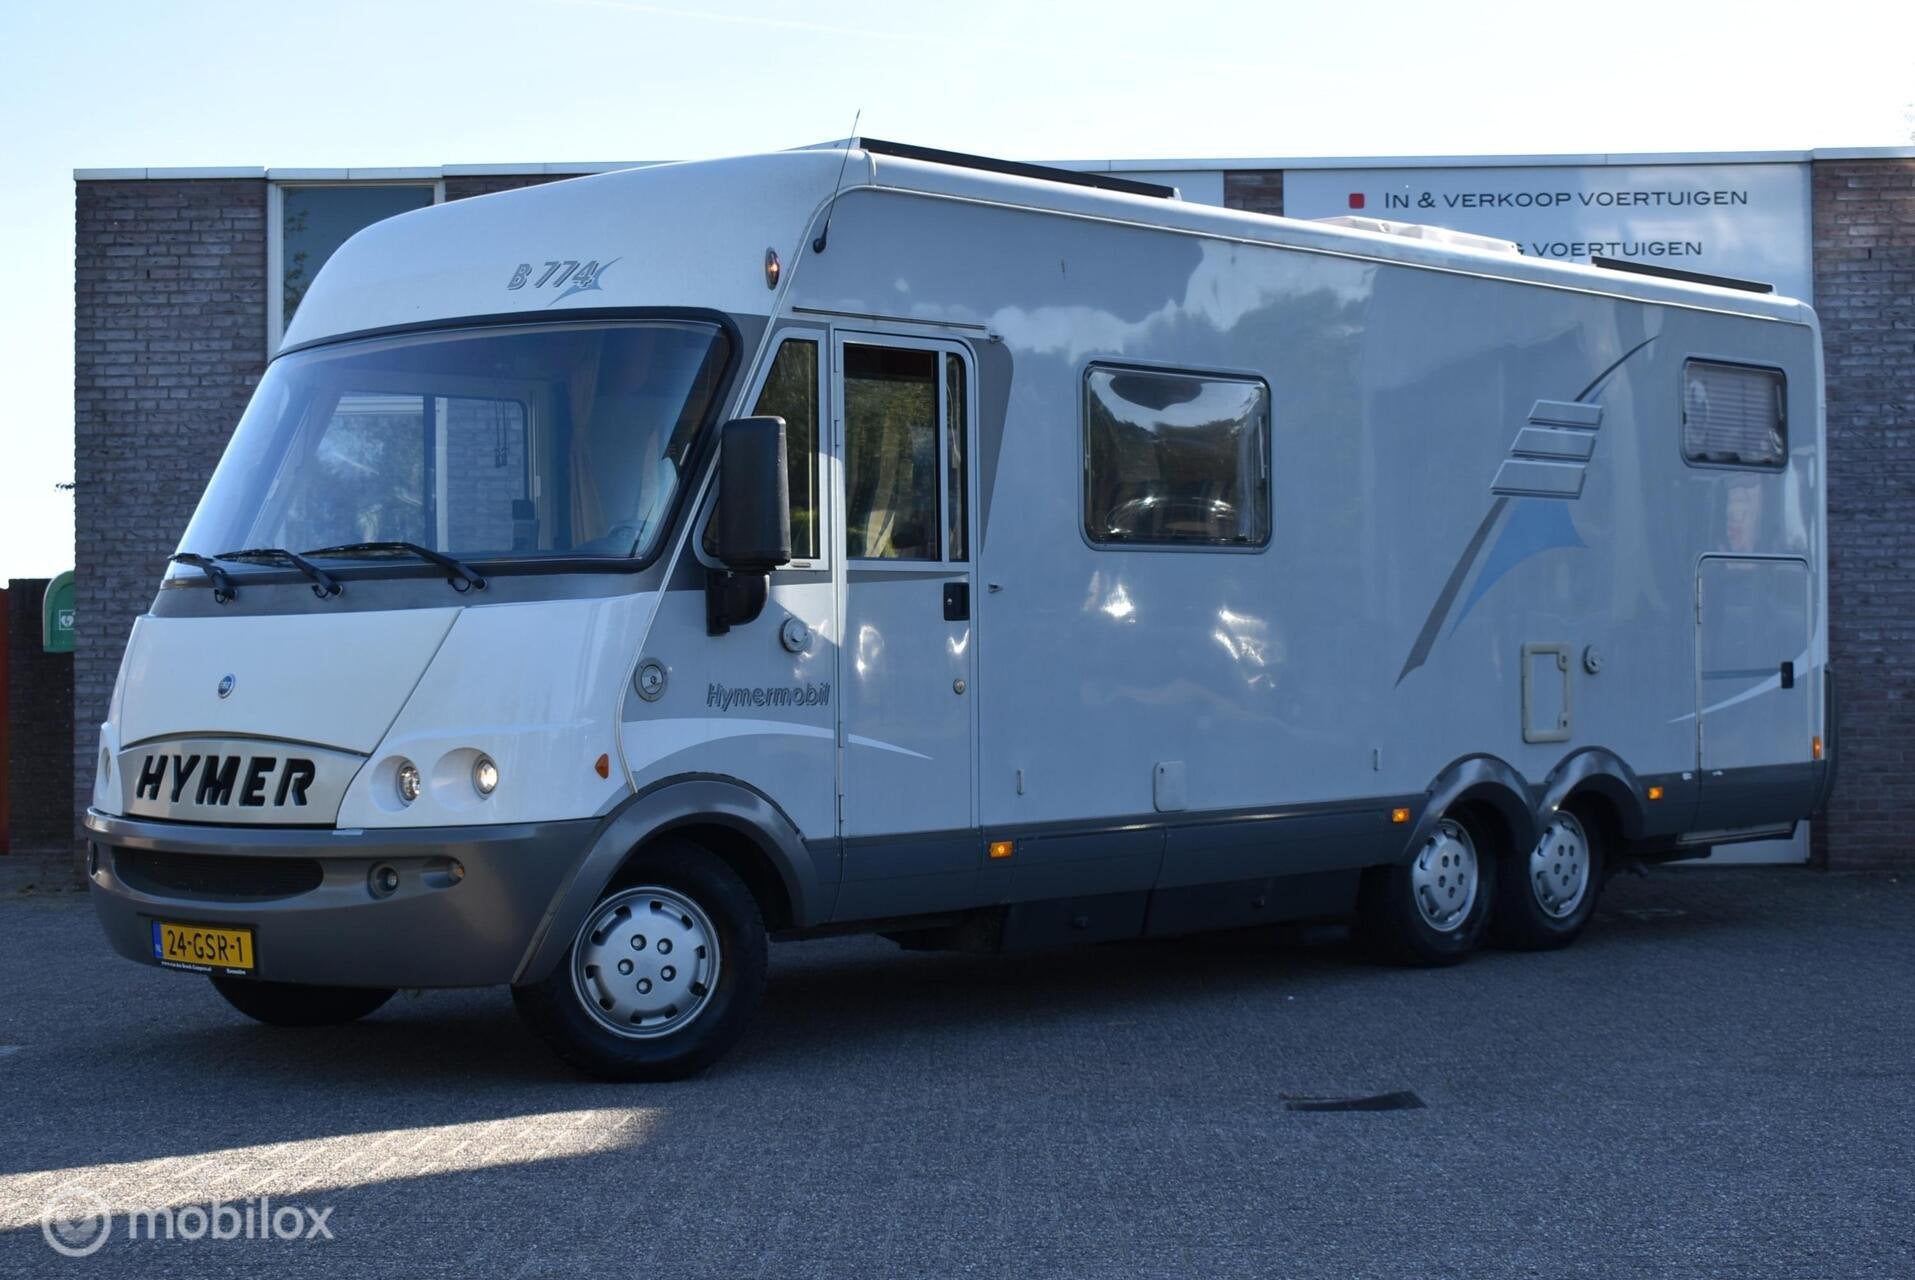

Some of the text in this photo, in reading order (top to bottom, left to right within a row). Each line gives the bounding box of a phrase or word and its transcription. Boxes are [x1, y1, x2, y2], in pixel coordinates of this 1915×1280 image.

[1384, 190, 1748, 209] IN & VERKOOP VOERTUIGEN
[1532, 240, 1702, 257] VOERTUIGEN
[507, 260, 600, 291] B 774
[706, 682, 832, 712] Hymermobil
[136, 754, 316, 807] HYMER
[167, 929, 243, 962] 24-GSR-1
